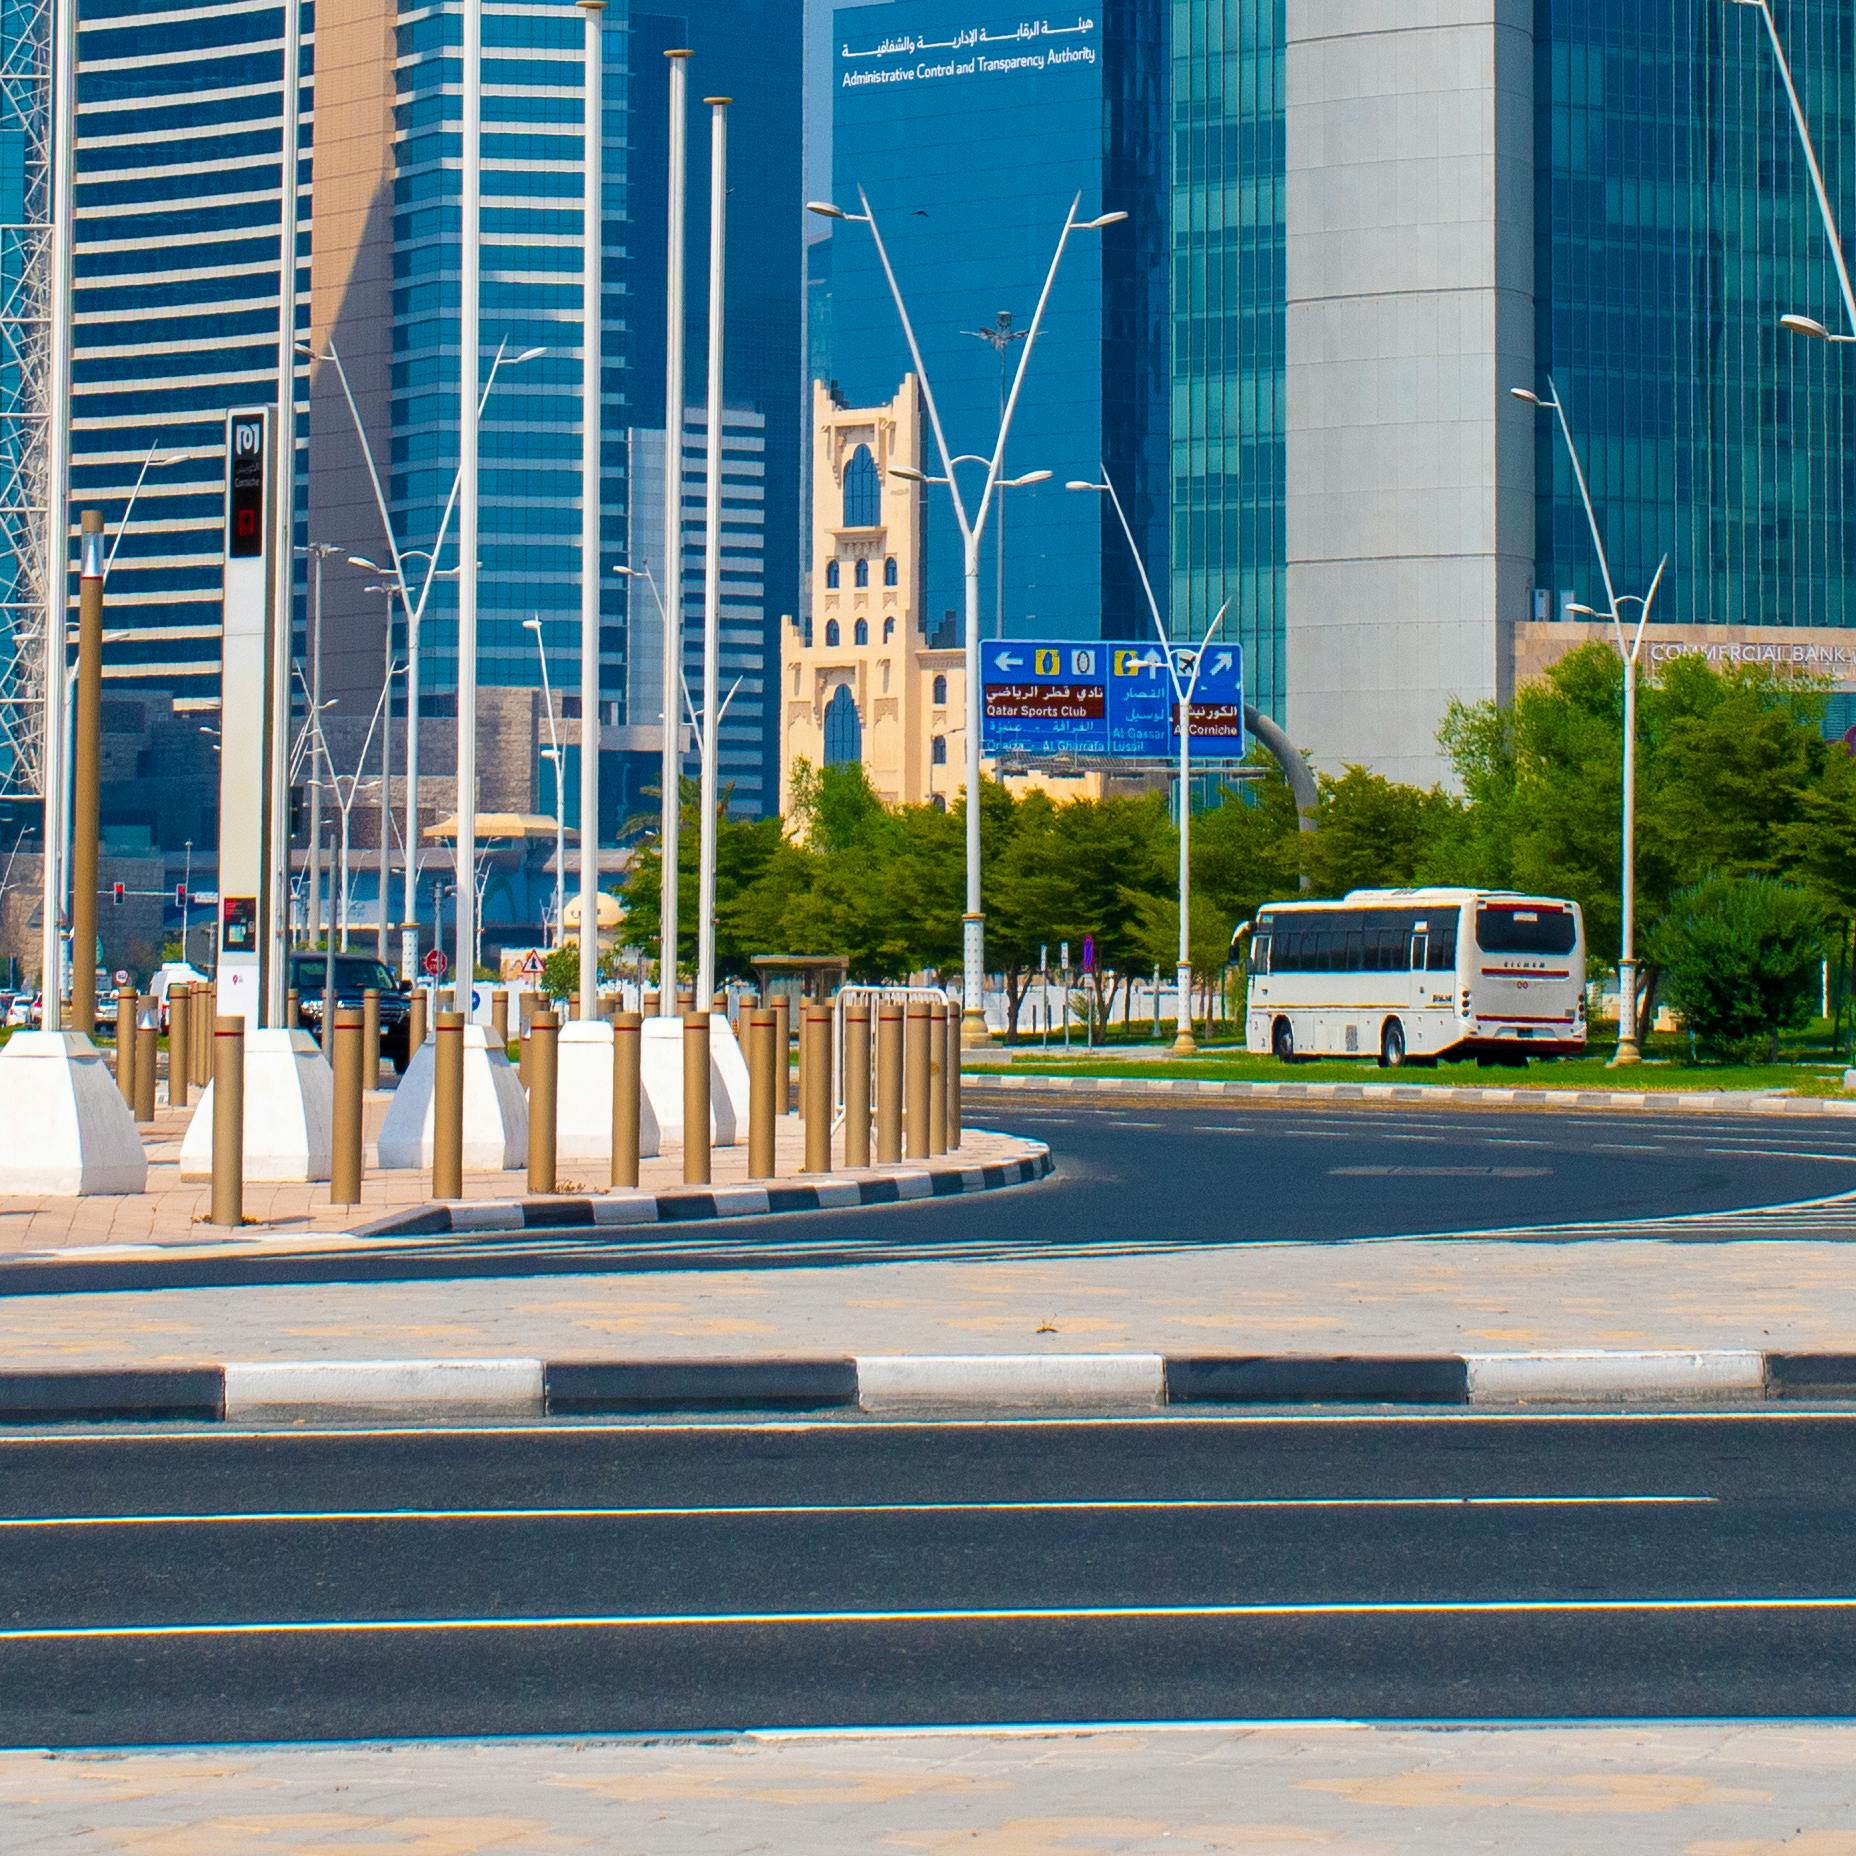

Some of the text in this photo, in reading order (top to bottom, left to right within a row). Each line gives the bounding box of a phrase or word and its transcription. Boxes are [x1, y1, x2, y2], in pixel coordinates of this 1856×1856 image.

[841, 16, 1094, 58] هيئة الرقابة الإدارية والشفافية
[842, 46, 1096, 87] Administrative Control and Transparency Authority
[1650, 643, 1846, 662] COMMERCIAL BANK
[986, 685, 1104, 701] نادي قطر الرياضي
[986, 704, 1087, 718] Qatar Sports Club
[1189, 724, 1238, 737] Corniche
